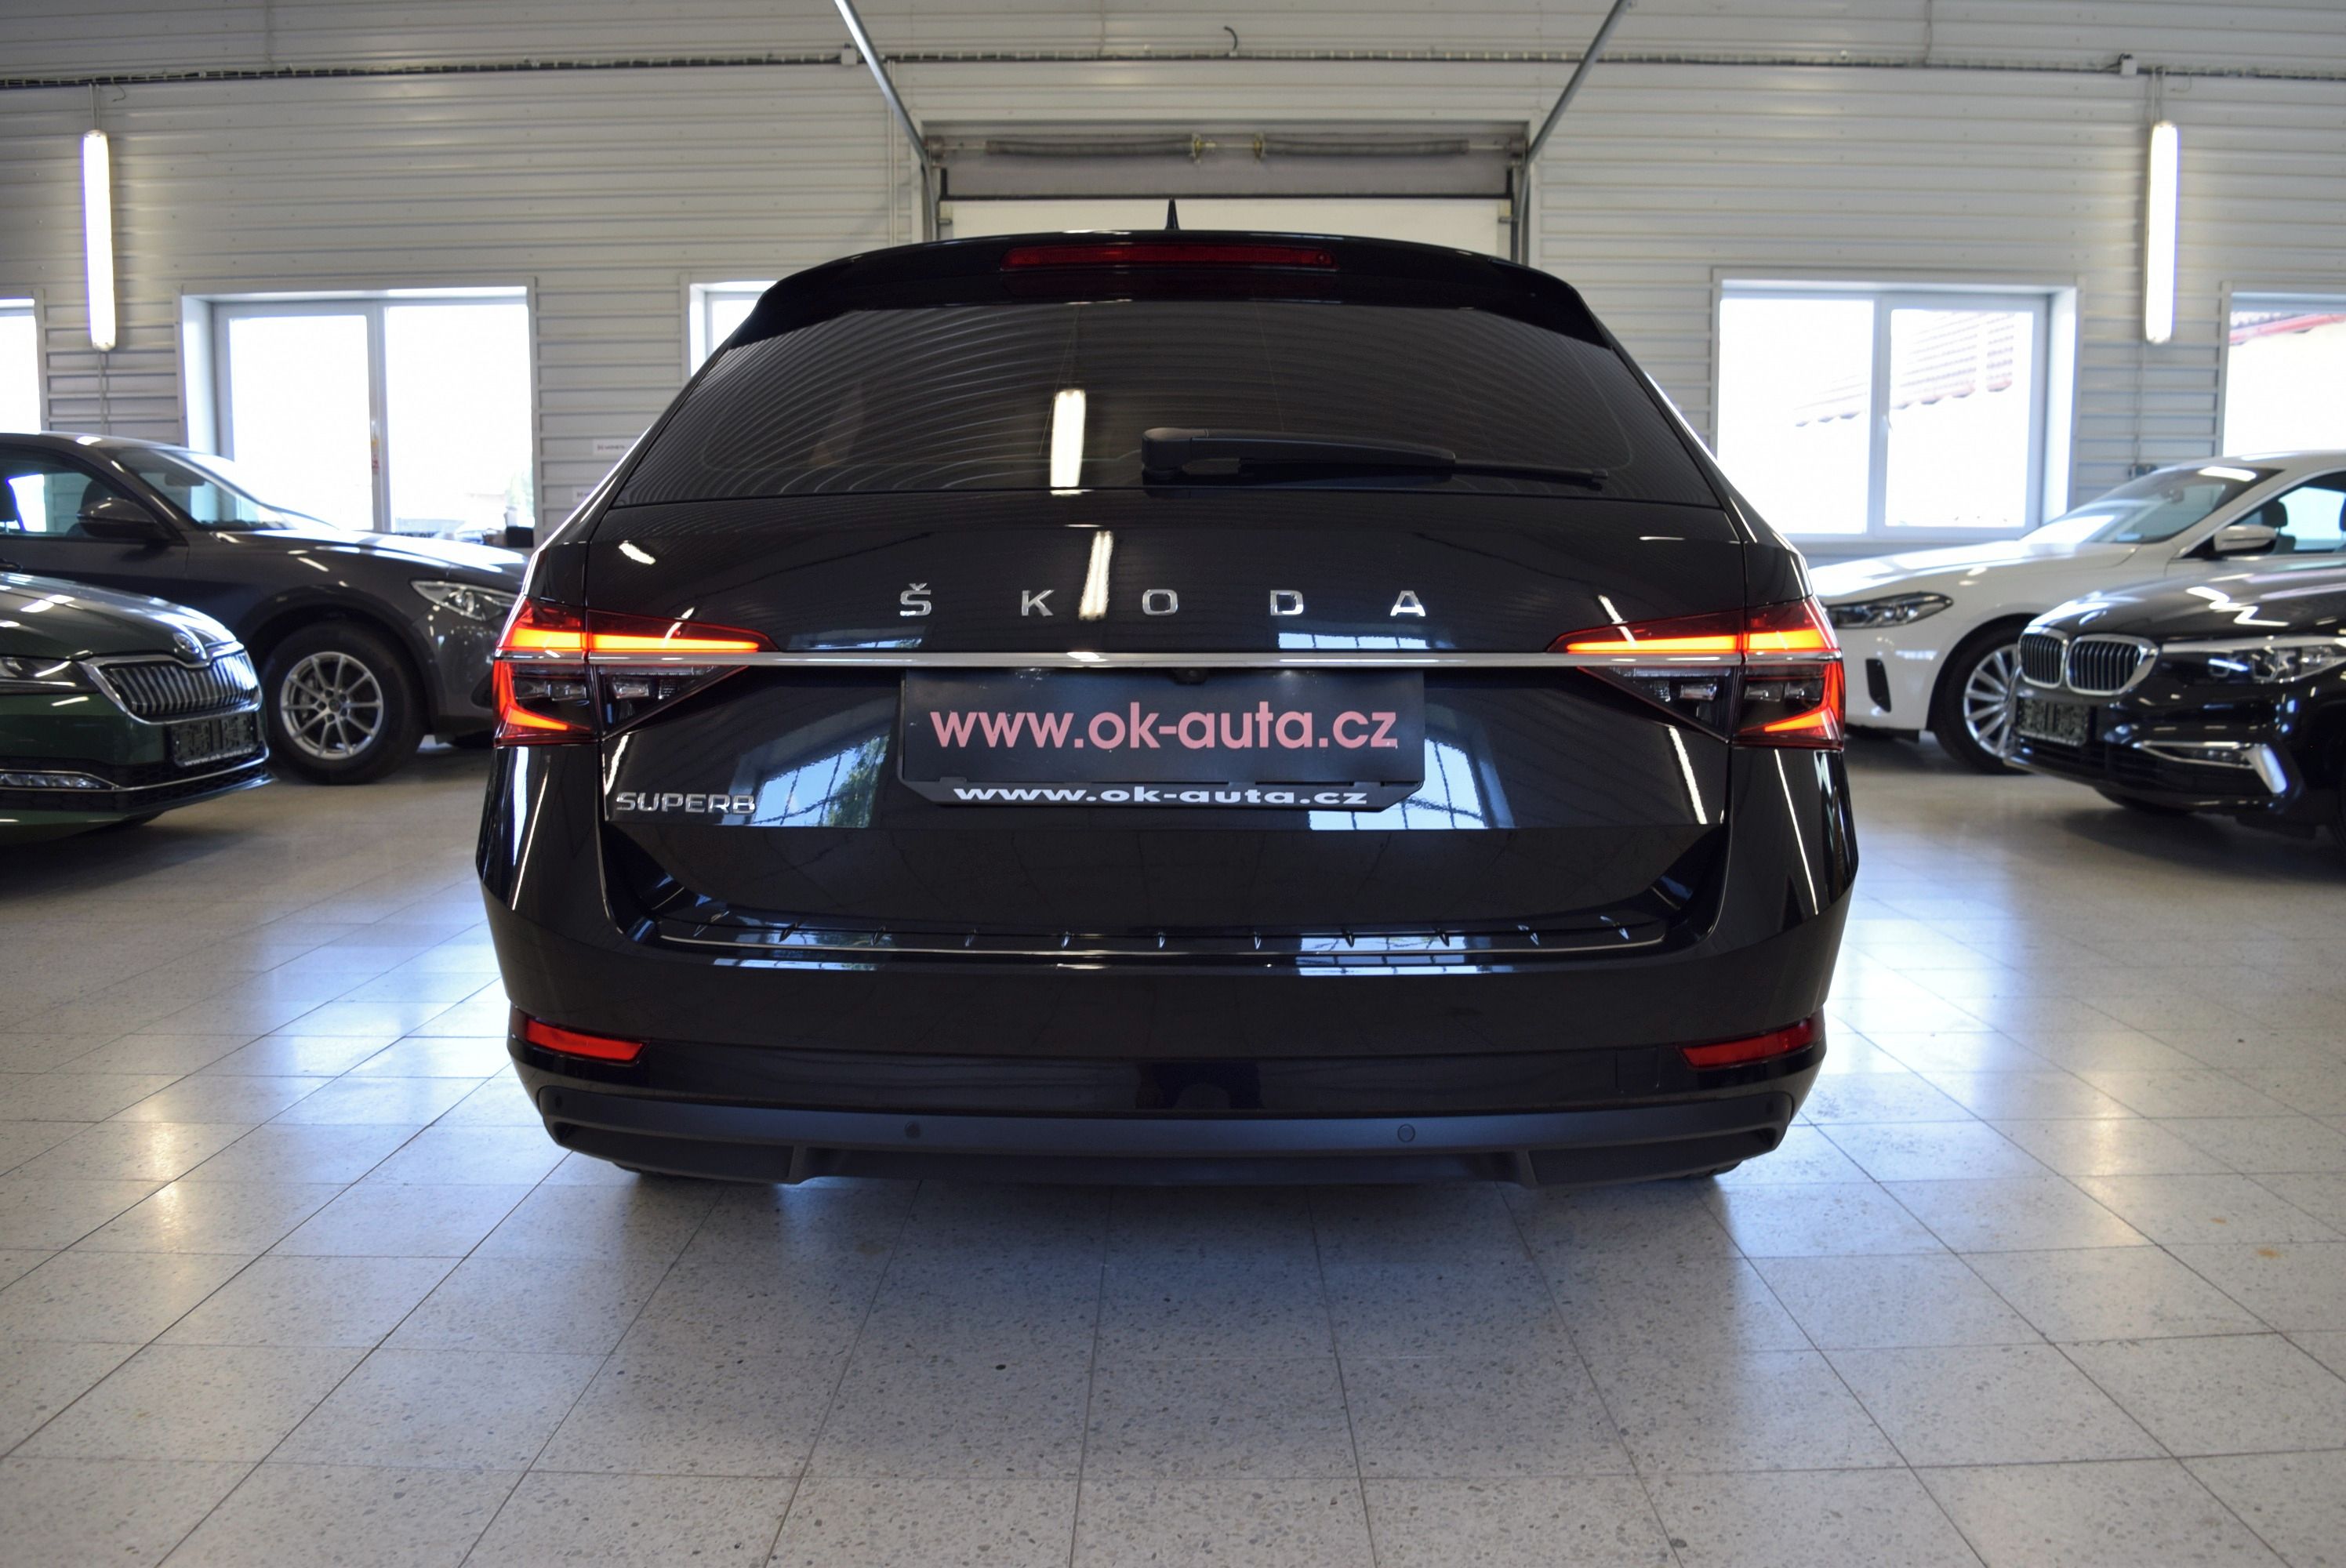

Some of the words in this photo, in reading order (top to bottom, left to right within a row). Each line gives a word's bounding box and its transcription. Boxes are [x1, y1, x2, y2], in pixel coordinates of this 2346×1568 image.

[930, 702, 1397, 749] www.ok-auta.cz
[616, 792, 755, 814] SUPERB
[953, 786, 1367, 805] www.ok-auta.cz
